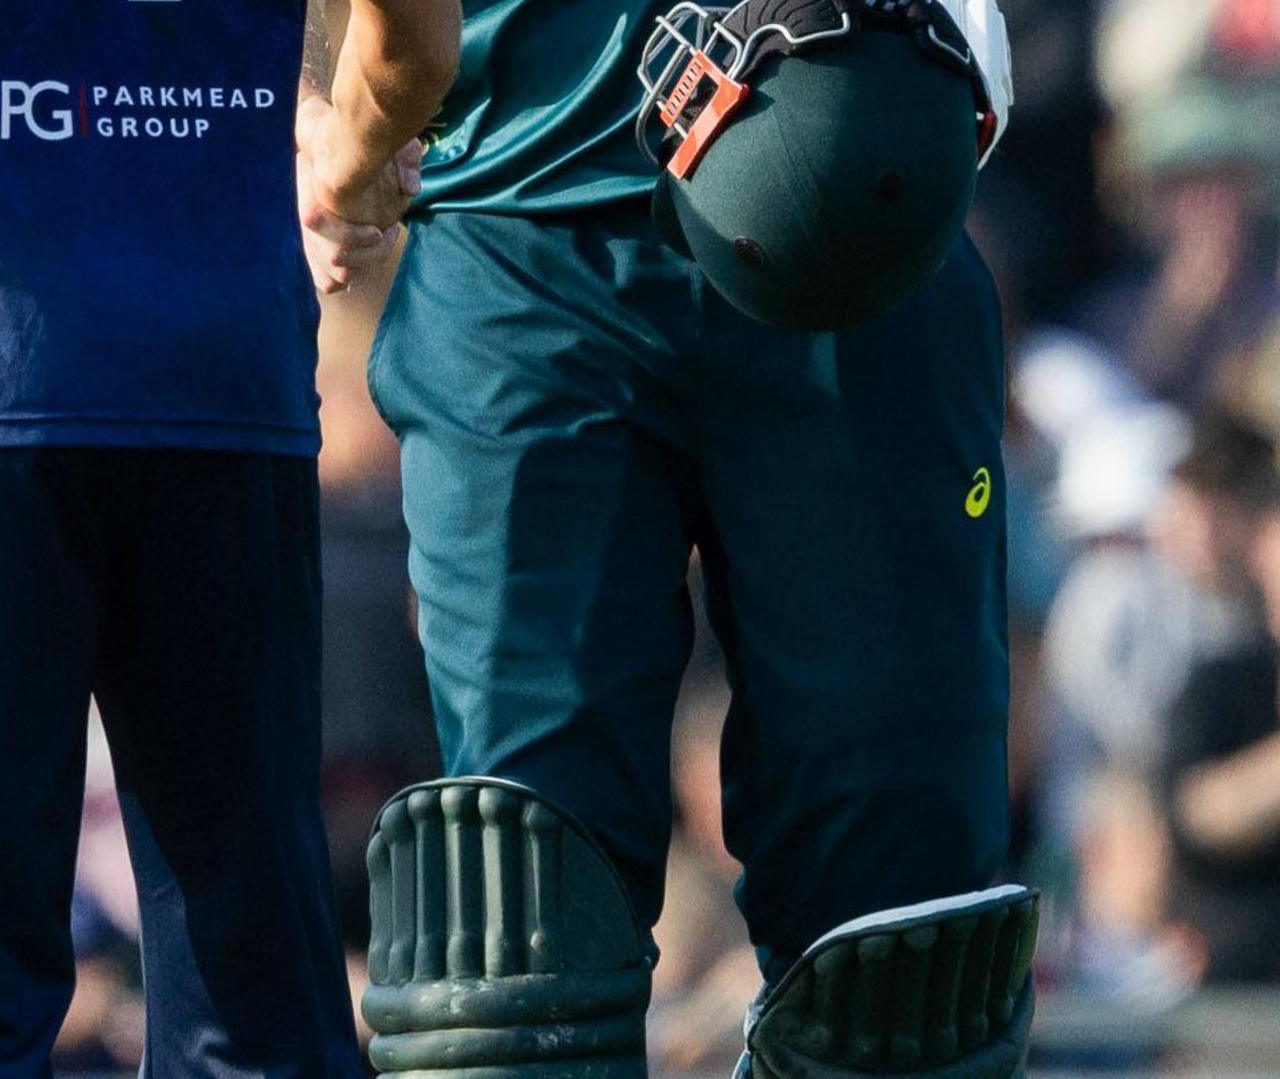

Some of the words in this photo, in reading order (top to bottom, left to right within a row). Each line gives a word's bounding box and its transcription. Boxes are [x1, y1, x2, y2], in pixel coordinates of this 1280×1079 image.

[93, 85, 275, 108] PARKMEAD
[0, 80, 73, 140] PG
[97, 117, 210, 138] GROUP
